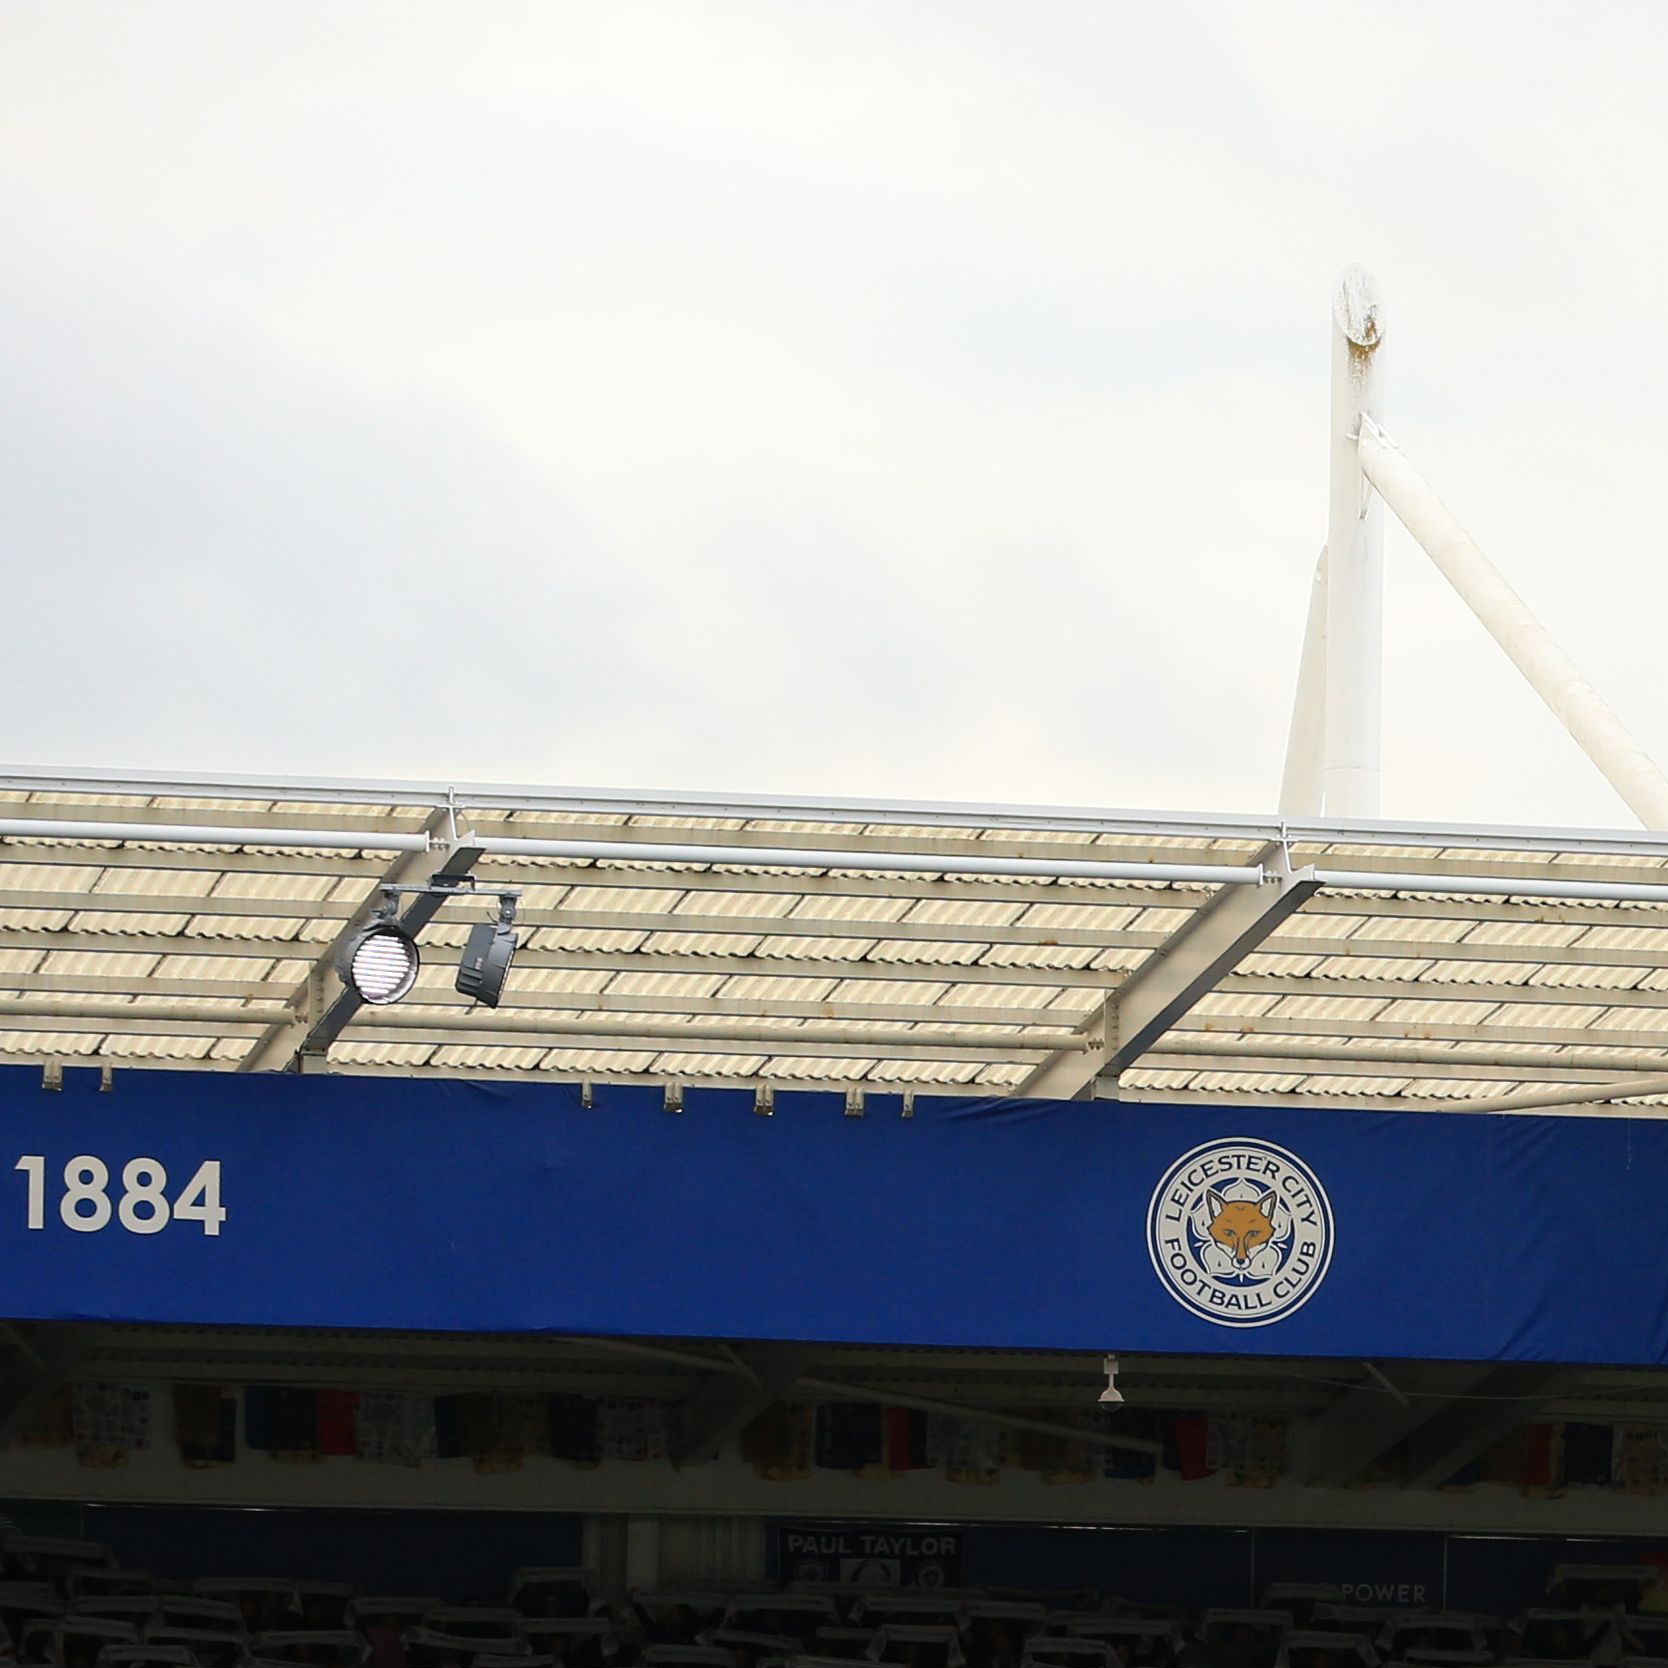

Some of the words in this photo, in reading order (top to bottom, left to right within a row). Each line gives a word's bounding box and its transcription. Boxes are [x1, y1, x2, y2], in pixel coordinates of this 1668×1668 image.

[15, 1155, 226, 1236] 1884
[1165, 1154, 1280, 1223] LEICESTER
[1281, 1175, 1318, 1227] CITY
[1165, 1237, 1273, 1311] FOOTBALL
[1273, 1240, 1317, 1300] CLUB
[788, 1534, 852, 1555] PAUL
[860, 1535, 957, 1557] TAYLOR
[1342, 1583, 1425, 1603] POWER
